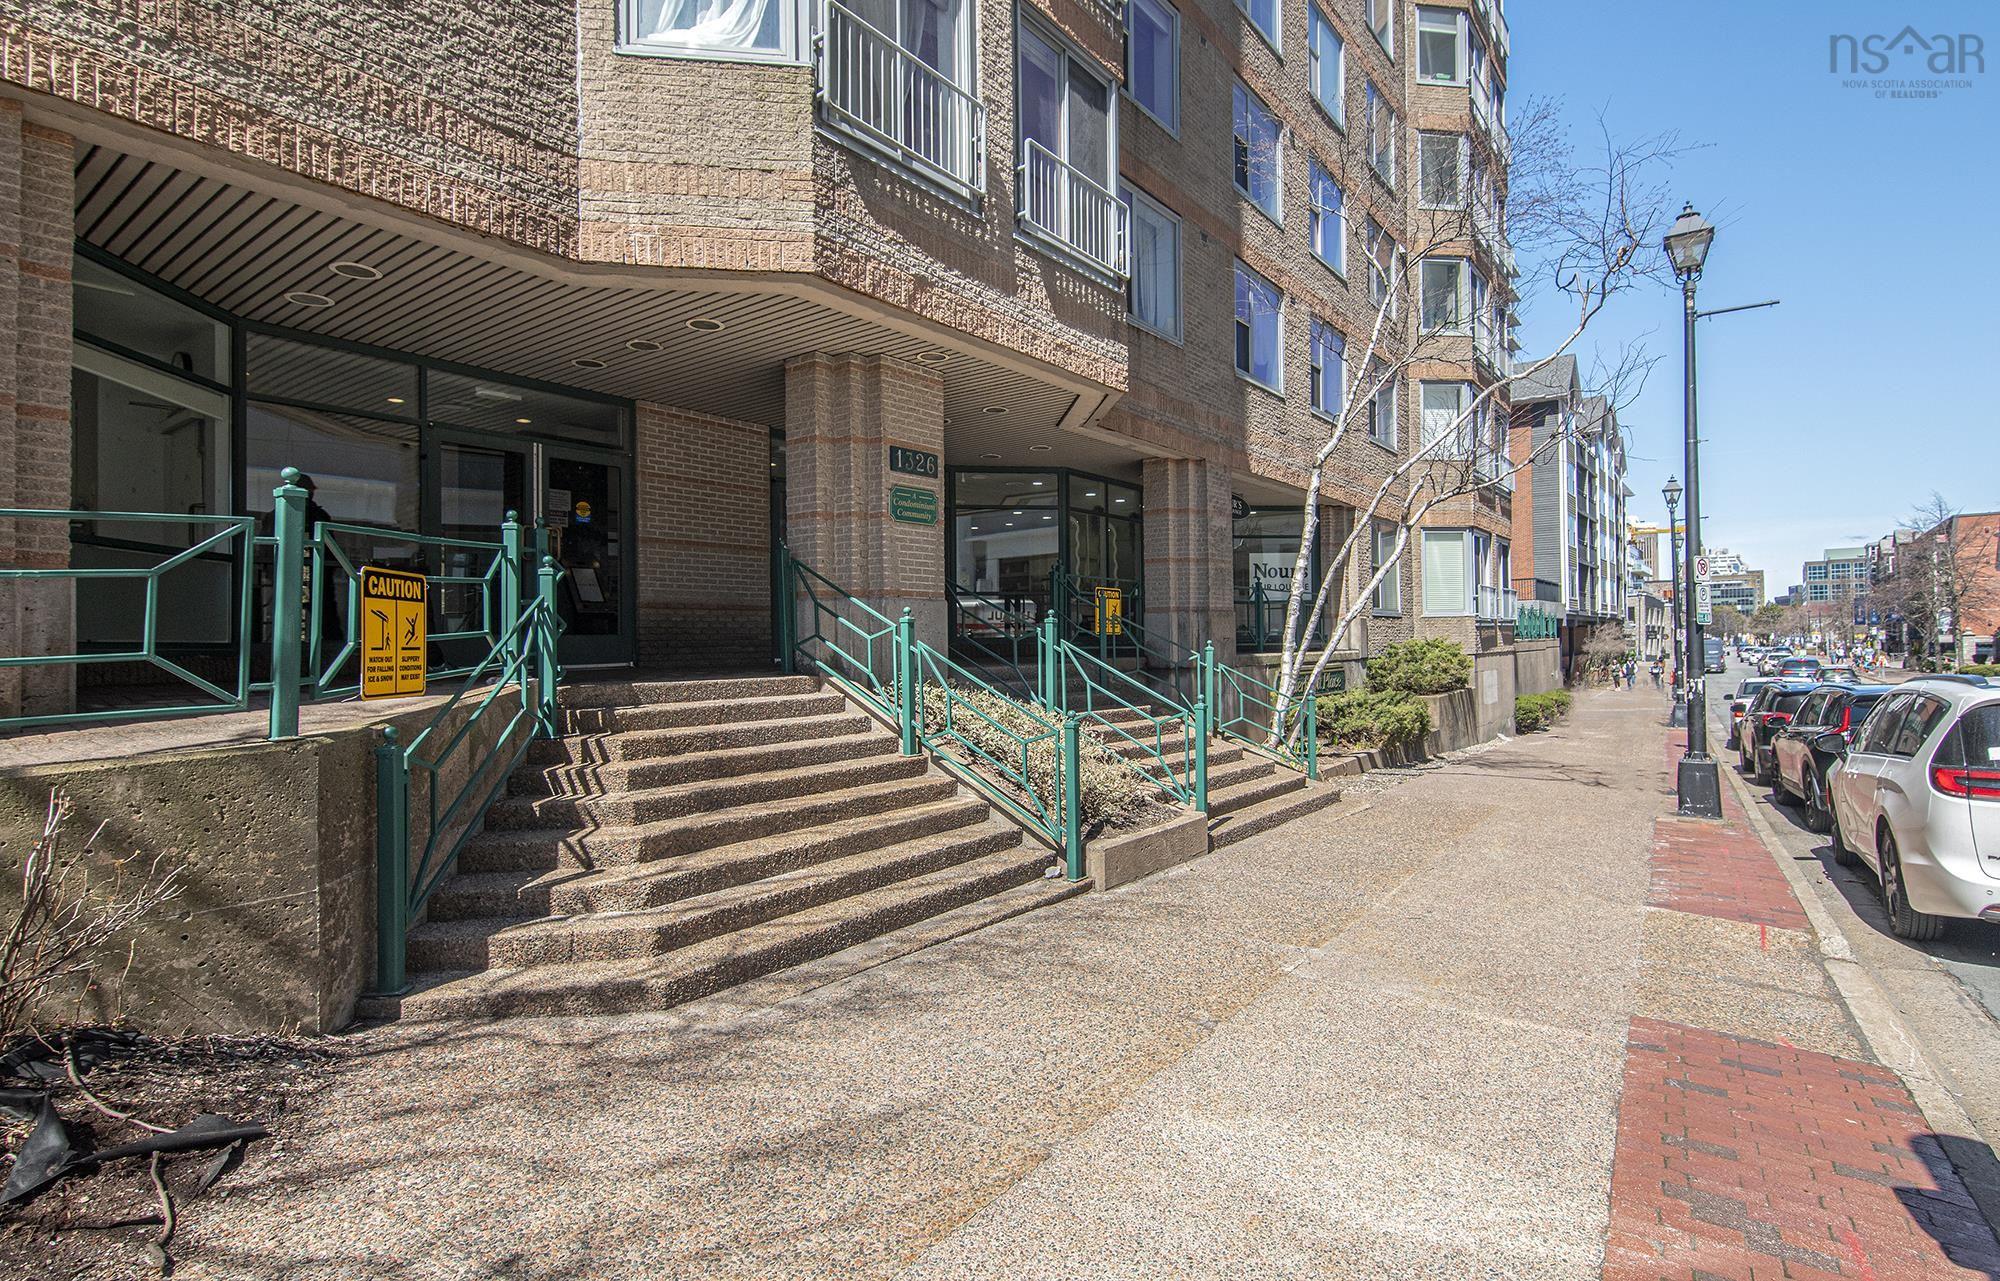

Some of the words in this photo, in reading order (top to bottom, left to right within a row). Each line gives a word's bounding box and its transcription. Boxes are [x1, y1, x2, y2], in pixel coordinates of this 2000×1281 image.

[896, 449, 935, 474] 1326
[893, 498, 936, 511] Condominium
[897, 508, 931, 521] Community
[368, 575, 421, 600] CAUTION
[401, 655, 420, 663] SLIPPERY
[367, 665, 376, 673] FOR
[399, 664, 422, 672] CONDITIONS
[367, 675, 376, 683] ICE
[376, 675, 380, 683] &
[380, 674, 393, 682] SNOW
[400, 673, 409, 681] MAY
